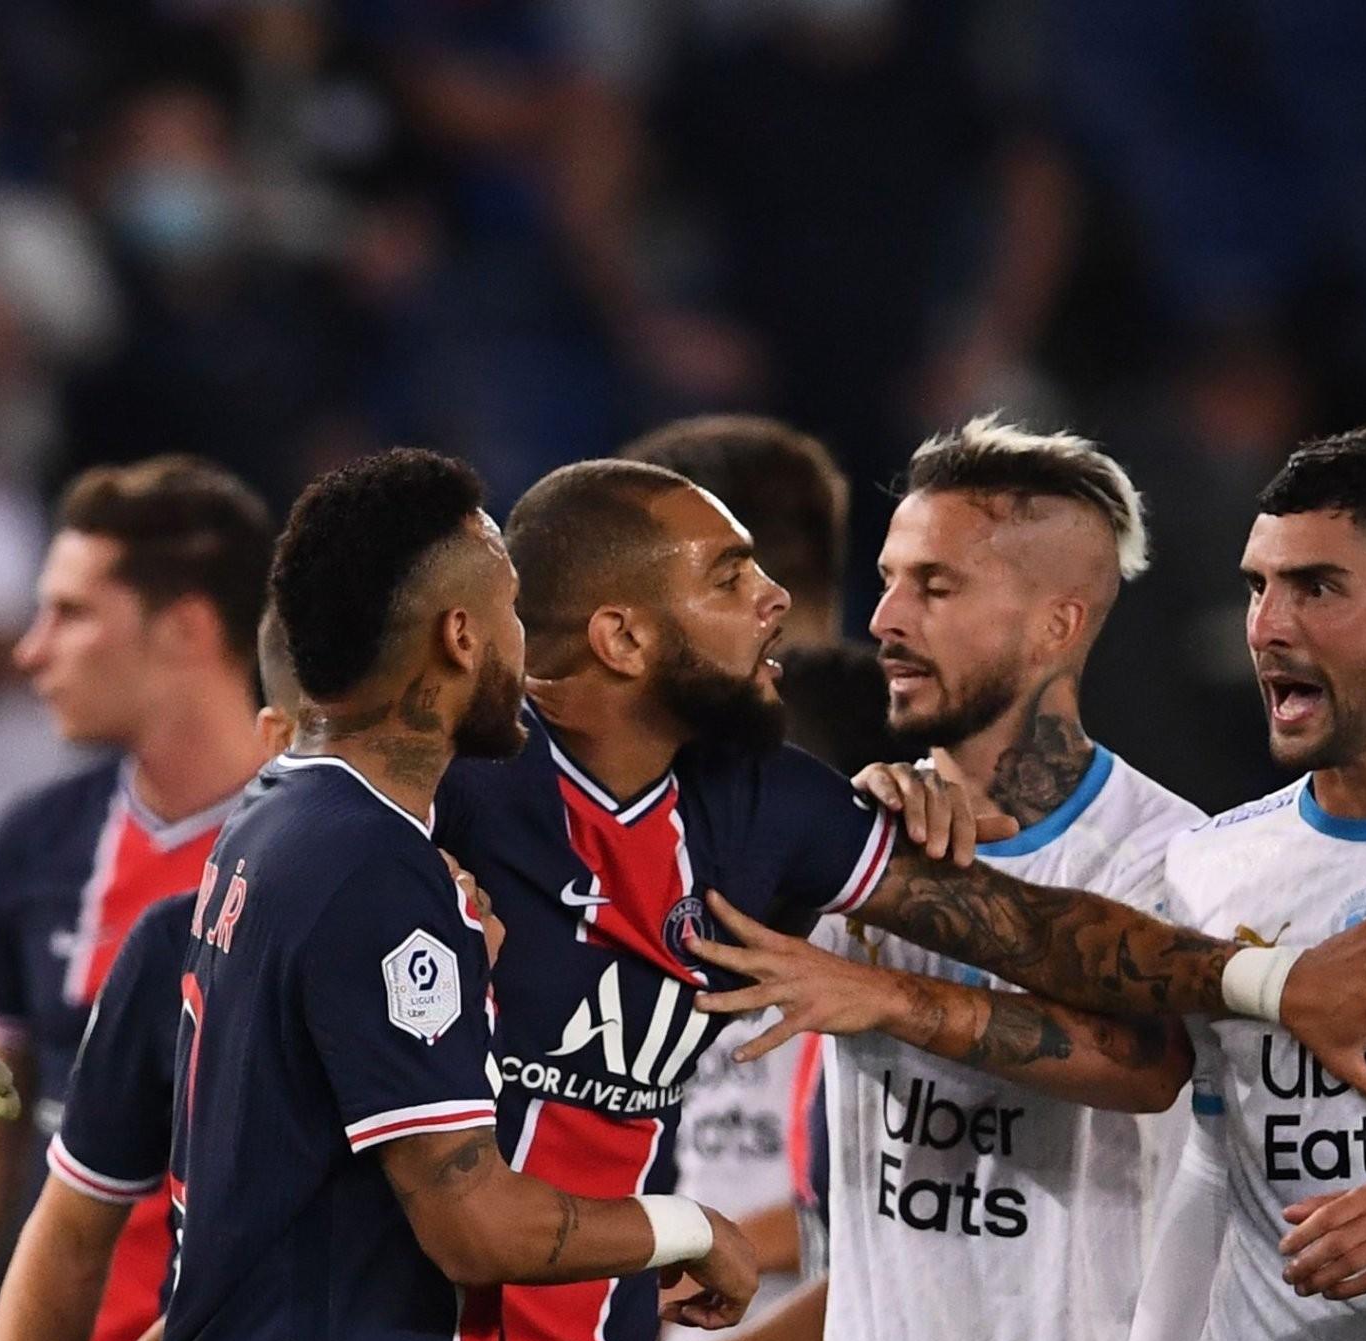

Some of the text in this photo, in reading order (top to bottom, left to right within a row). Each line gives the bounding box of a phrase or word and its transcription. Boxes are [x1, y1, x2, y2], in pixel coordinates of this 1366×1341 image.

[502, 1056, 560, 1094] COR
[564, 1073, 627, 1112] LIVE
[884, 1070, 1024, 1156] Uber
[878, 1151, 1028, 1238] Eats
